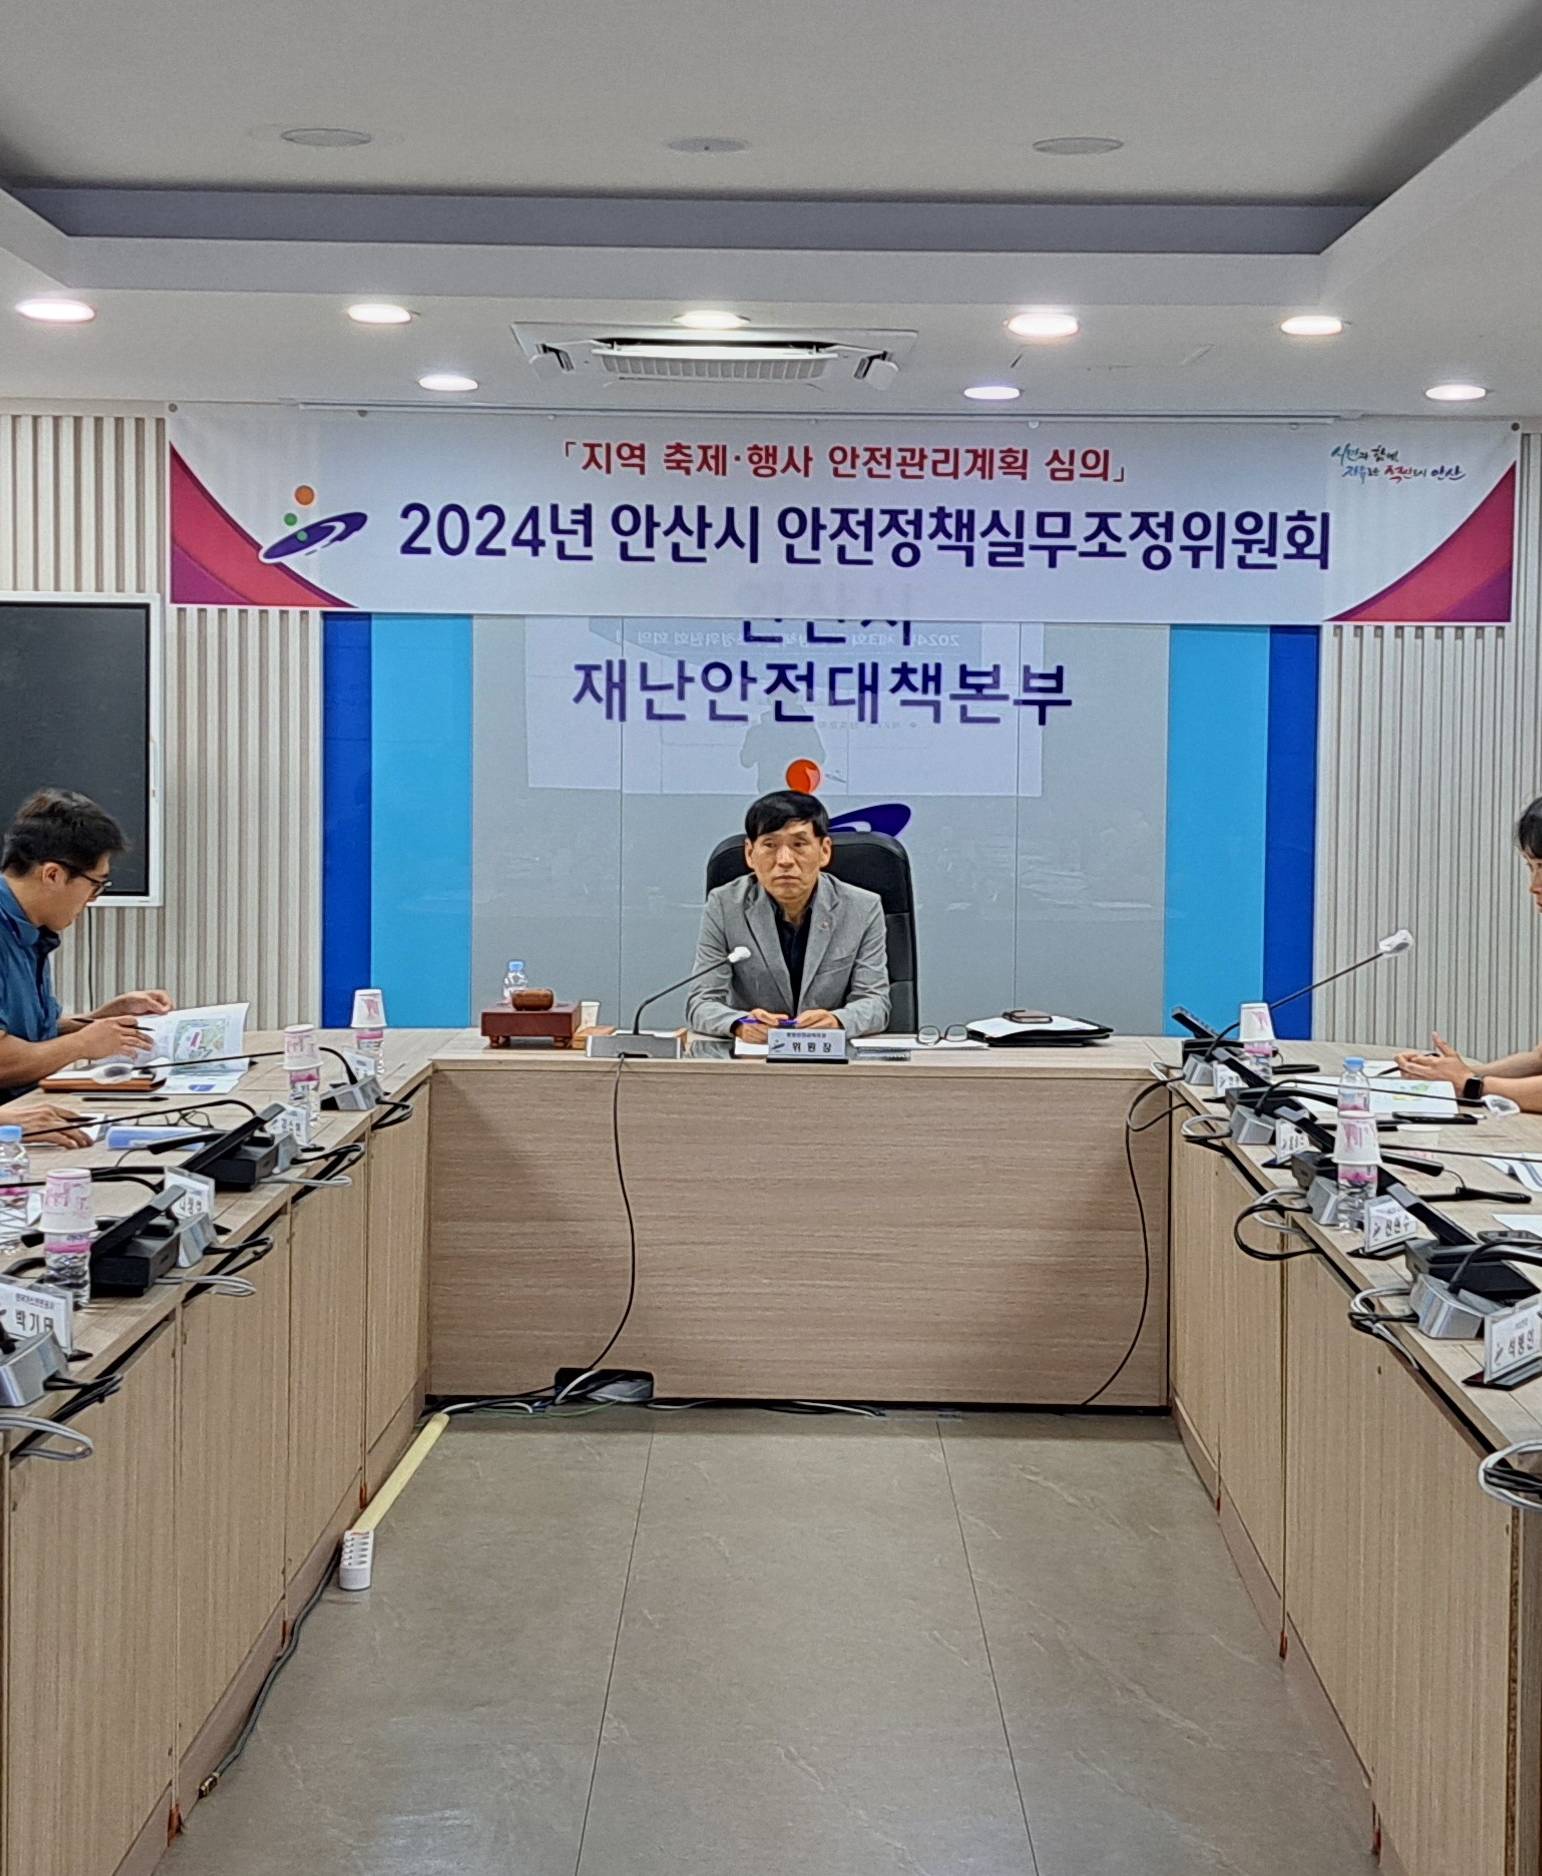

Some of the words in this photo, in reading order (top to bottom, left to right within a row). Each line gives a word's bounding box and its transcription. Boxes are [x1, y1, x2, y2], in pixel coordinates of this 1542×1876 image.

[662, 441, 815, 479] 축제·행사
[828, 445, 1030, 481] 안전관리계획
[399, 502, 594, 562] 2024년
[609, 503, 760, 564] 안산시
[777, 505, 1331, 571] 안전정책실무조정위원회
[571, 659, 1073, 727] 재난안전대책본부
